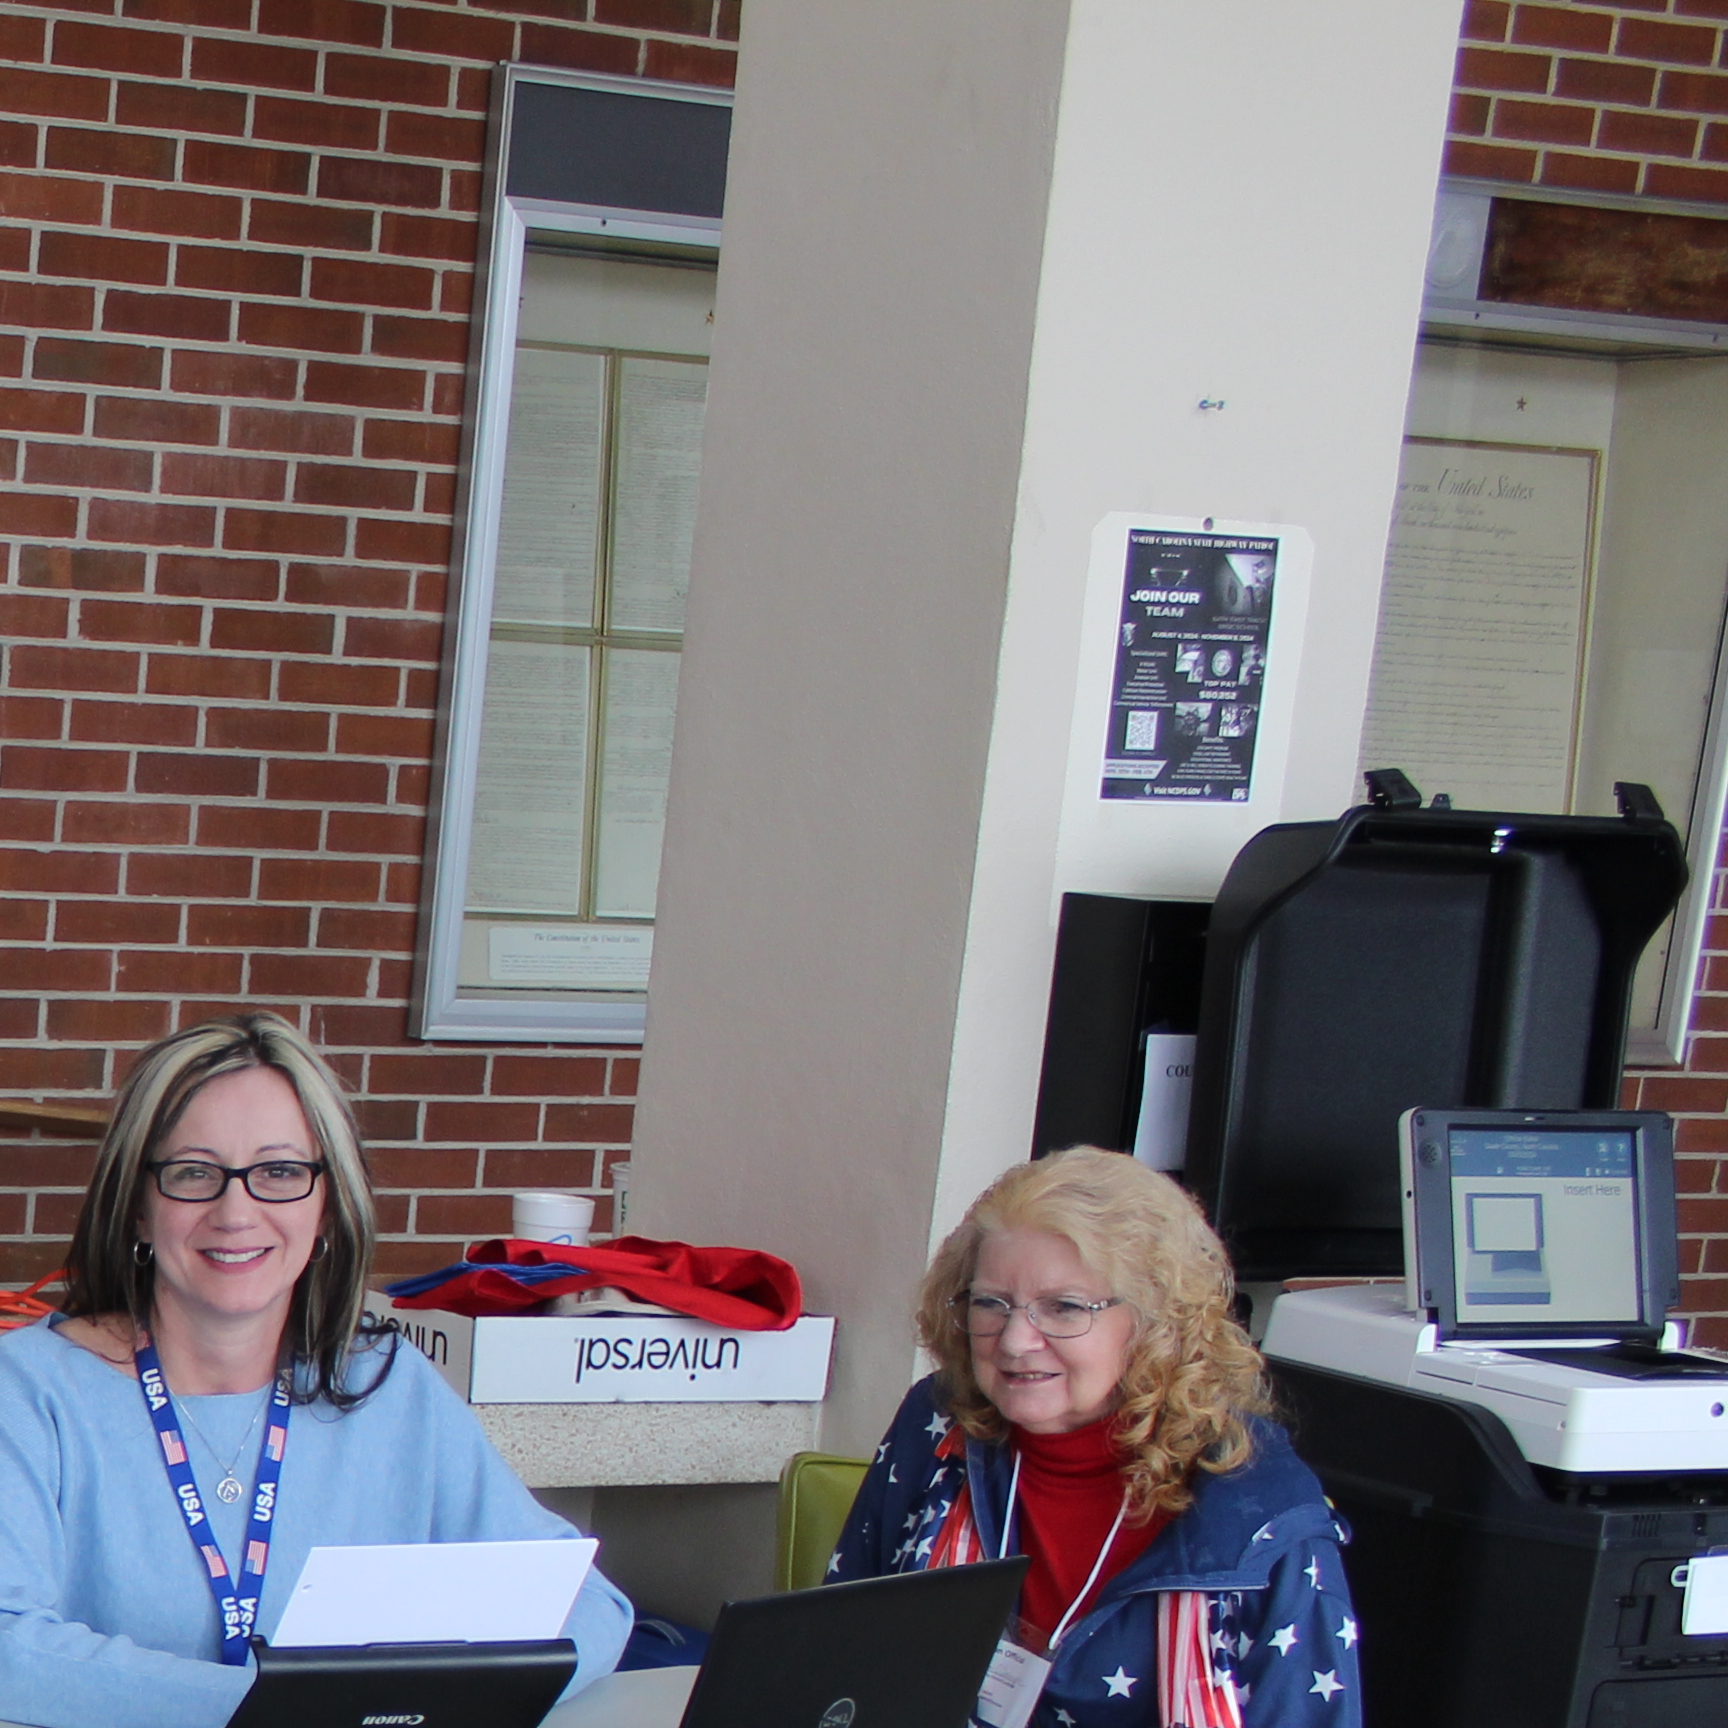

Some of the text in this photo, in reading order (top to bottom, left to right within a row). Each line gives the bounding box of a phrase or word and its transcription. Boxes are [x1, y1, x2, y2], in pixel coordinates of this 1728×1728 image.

[1437, 468, 1487, 497] United
[1130, 589, 1200, 604] JOIN OUR
[1145, 605, 1185, 618] TEAM
[1563, 1184, 1621, 1196] Insert Here
[575, 1336, 741, 1384] universal
[141, 1367, 169, 1412] USA
[273, 1368, 294, 1408] USA
[177, 1482, 205, 1527] USA
[253, 1481, 277, 1523] USA
[221, 1596, 241, 1640] USA
[361, 1714, 425, 1726] Canon
